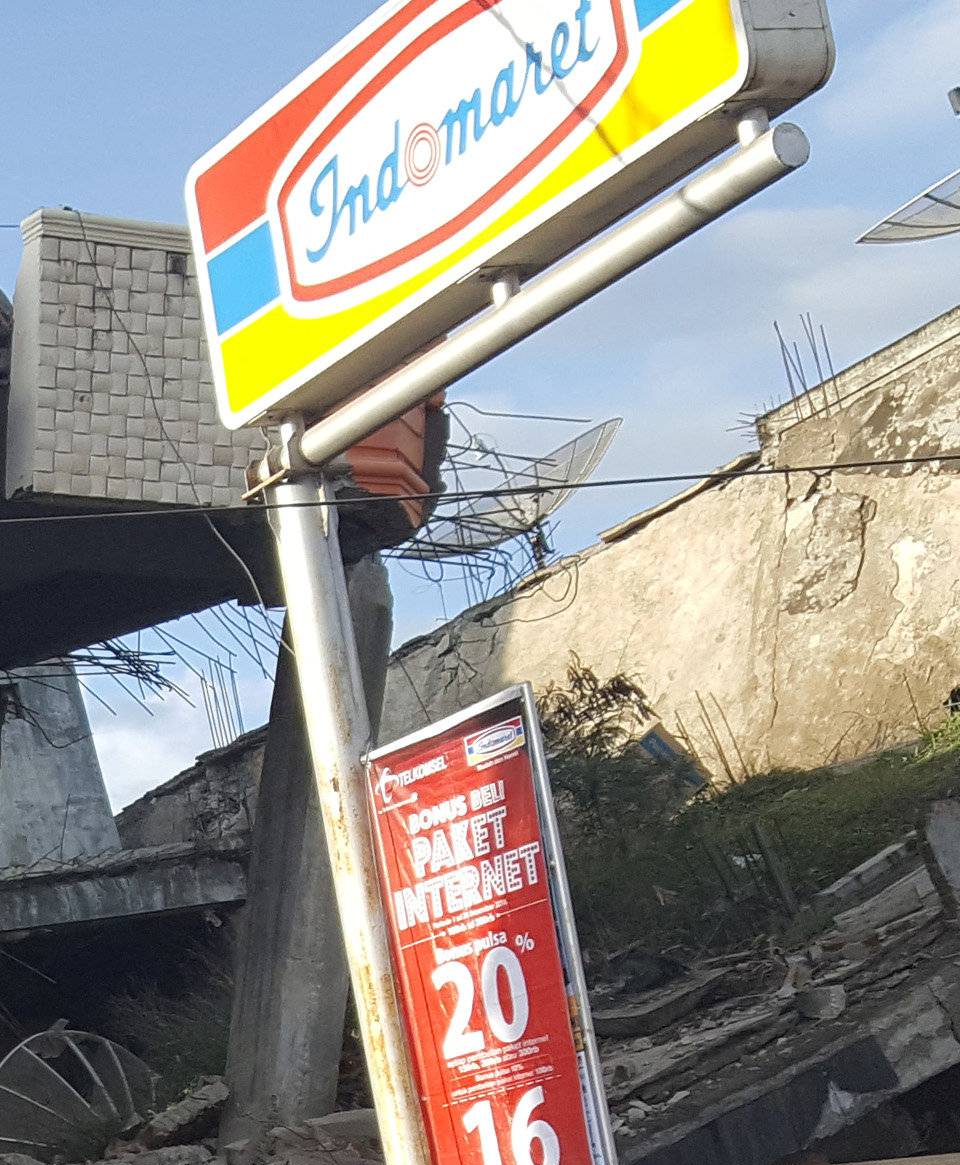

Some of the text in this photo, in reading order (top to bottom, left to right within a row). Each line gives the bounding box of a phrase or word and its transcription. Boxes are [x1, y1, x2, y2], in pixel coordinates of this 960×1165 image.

[306, 0, 600, 262] Indomaret
[397, 756, 448, 787] TELKOMSEL
[408, 795, 468, 835] BONUS
[470, 780, 505, 811] BELI
[411, 806, 507, 879] PAKET
[394, 842, 540, 931] INTERNET
[474, 931, 507, 956] pulsa
[431, 946, 529, 1061] 20
[515, 932, 535, 953] %
